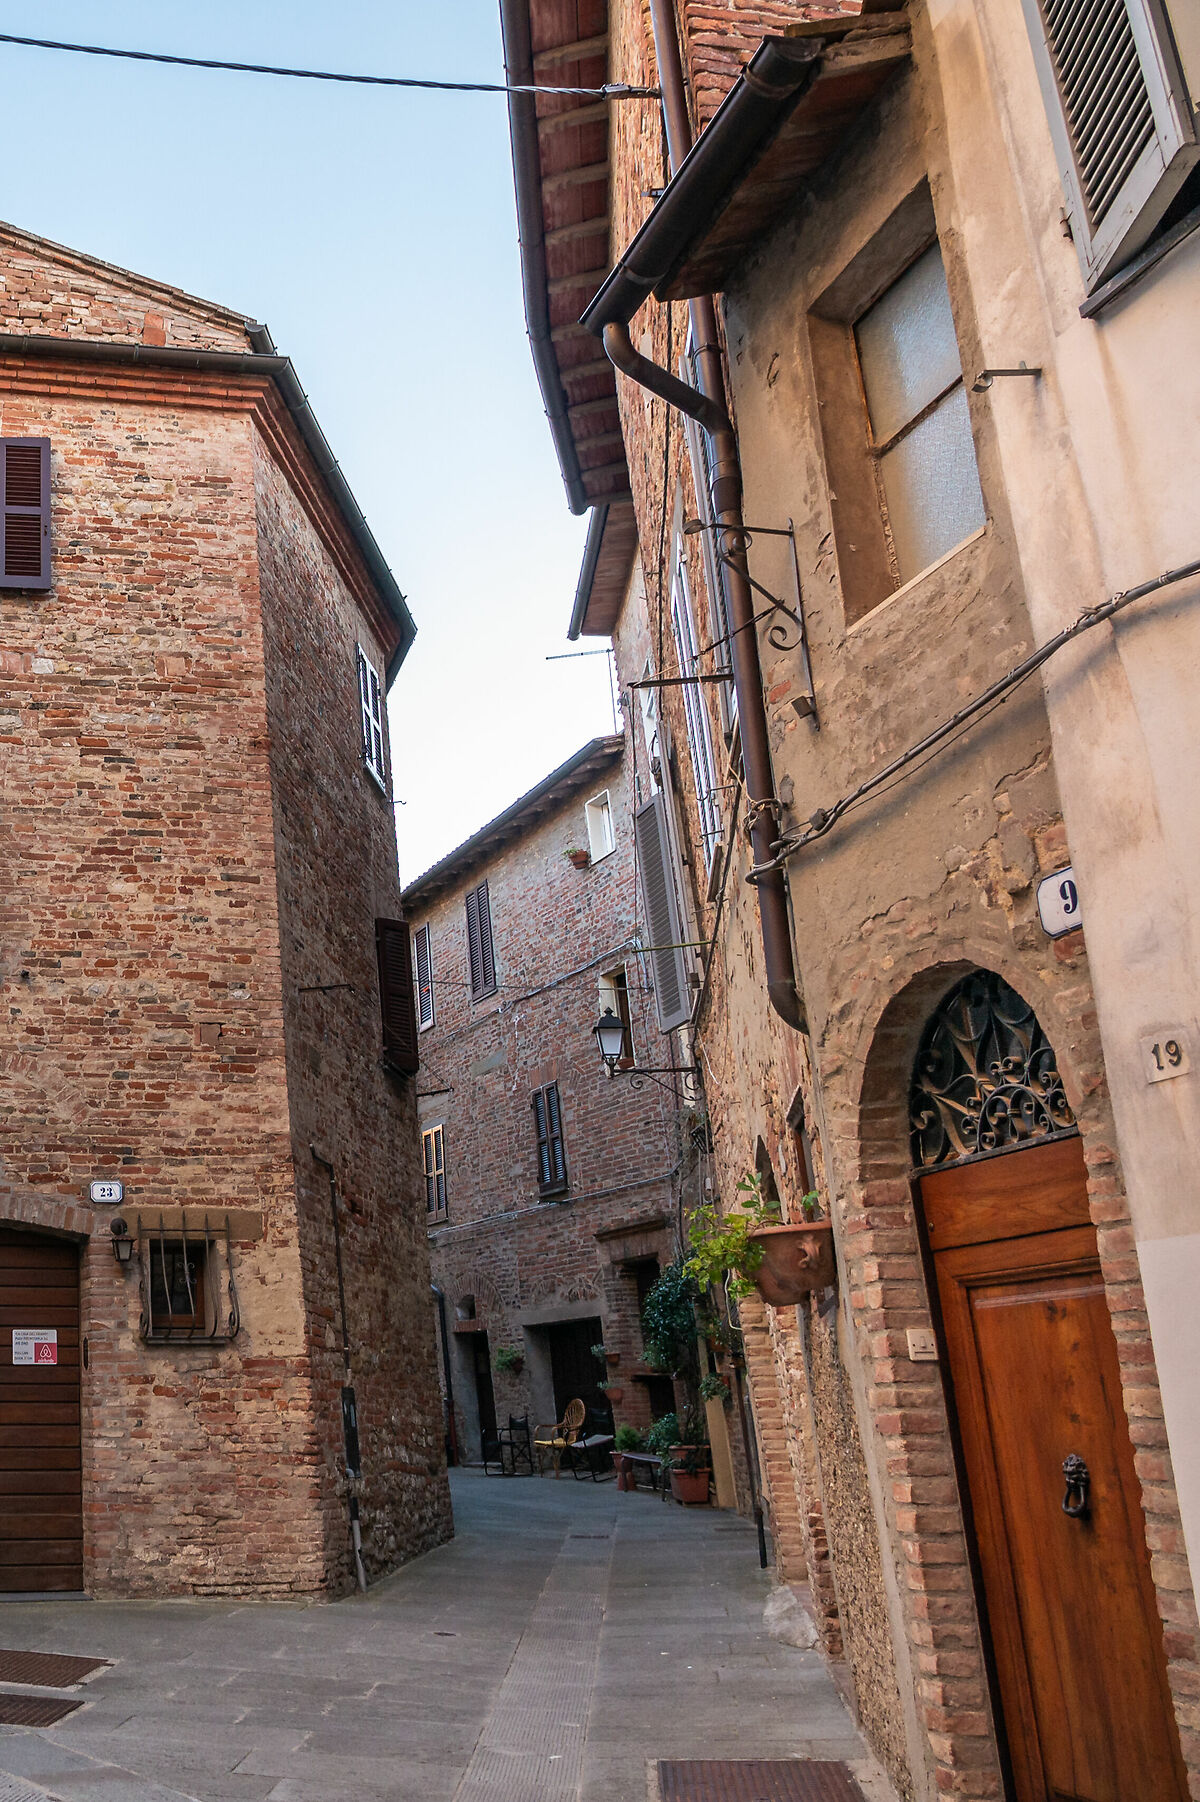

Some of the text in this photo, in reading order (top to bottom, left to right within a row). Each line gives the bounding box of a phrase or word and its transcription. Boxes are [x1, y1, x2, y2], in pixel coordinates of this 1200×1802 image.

[1059, 879, 1078, 915] 9
[1151, 1040, 1182, 1070] 19
[100, 1187, 113, 1198] 23
